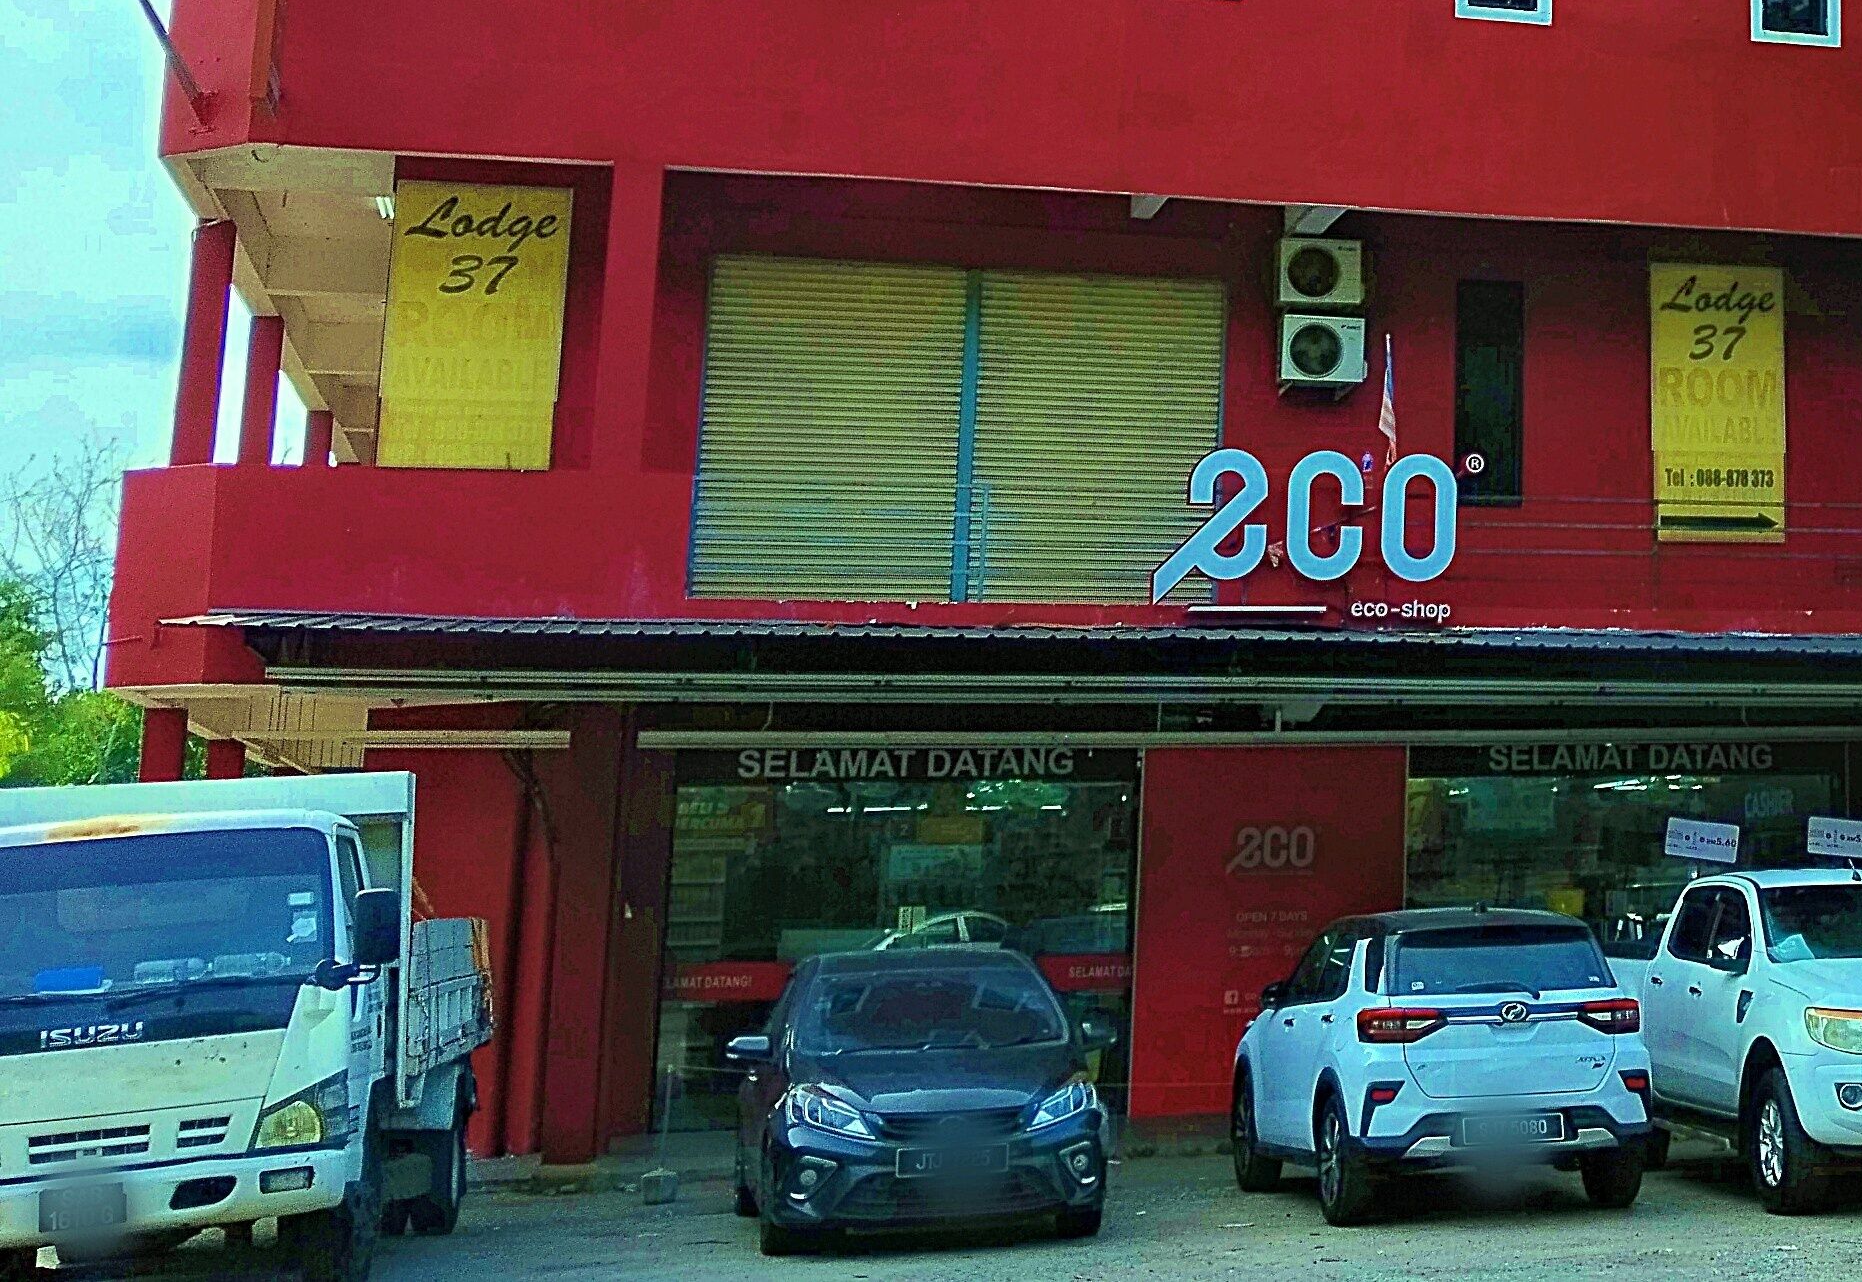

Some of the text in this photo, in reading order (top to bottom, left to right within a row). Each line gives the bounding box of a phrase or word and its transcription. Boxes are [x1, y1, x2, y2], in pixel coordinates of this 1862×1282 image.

[404, 196, 558, 253] Lodge
[438, 254, 519, 295] 37
[1660, 275, 1775, 323] Lodge
[1689, 324, 1746, 361] 37
[1658, 366, 1777, 409] ROOM
[1351, 600, 1451, 623] eco-shop
[738, 748, 1074, 778] SELAMAT DATANG
[1488, 742, 1773, 773] SELAMAT DATANG
[39, 1020, 144, 1050] ISUZU
